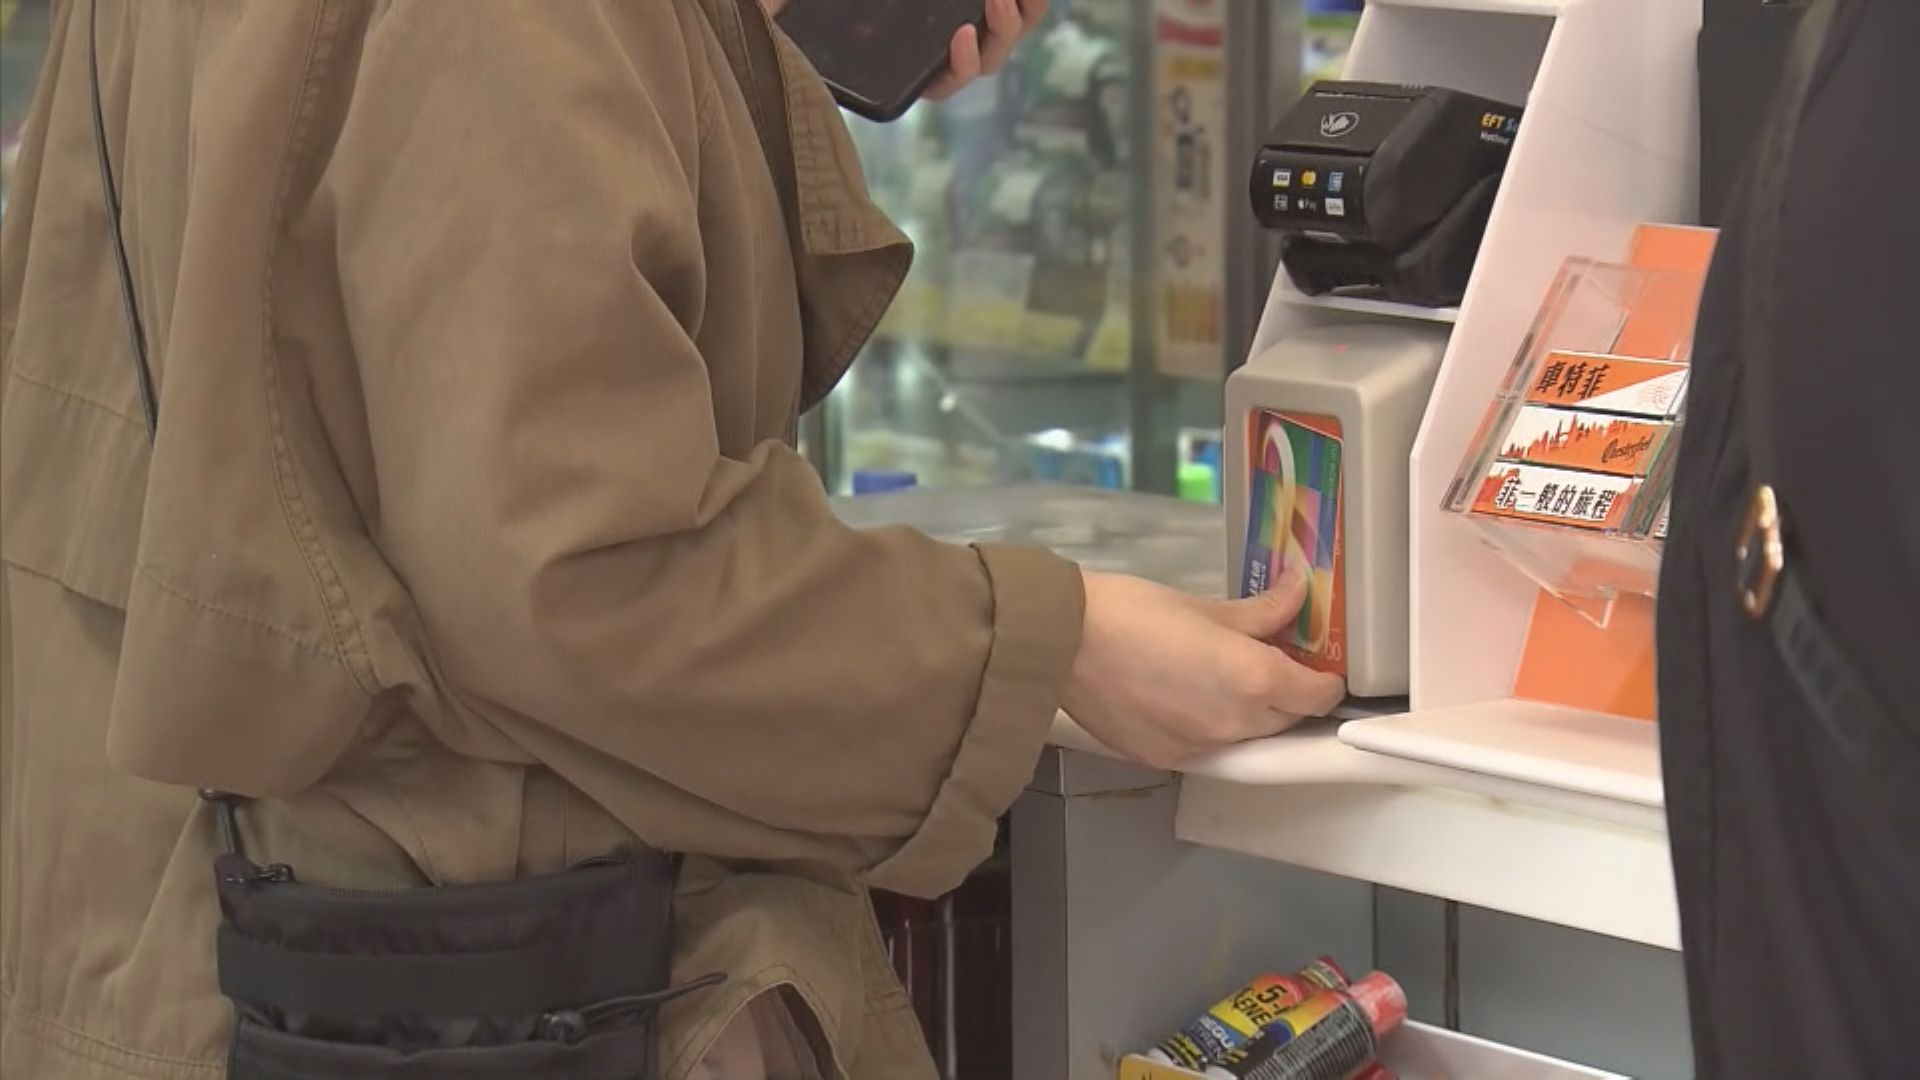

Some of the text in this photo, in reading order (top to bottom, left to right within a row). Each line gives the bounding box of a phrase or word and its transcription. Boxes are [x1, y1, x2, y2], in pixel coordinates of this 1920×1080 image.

[1481, 112, 1505, 129] EFT
[1535, 360, 1610, 400] 卓特菲
[1495, 477, 1617, 520] 菲一般的旅程
